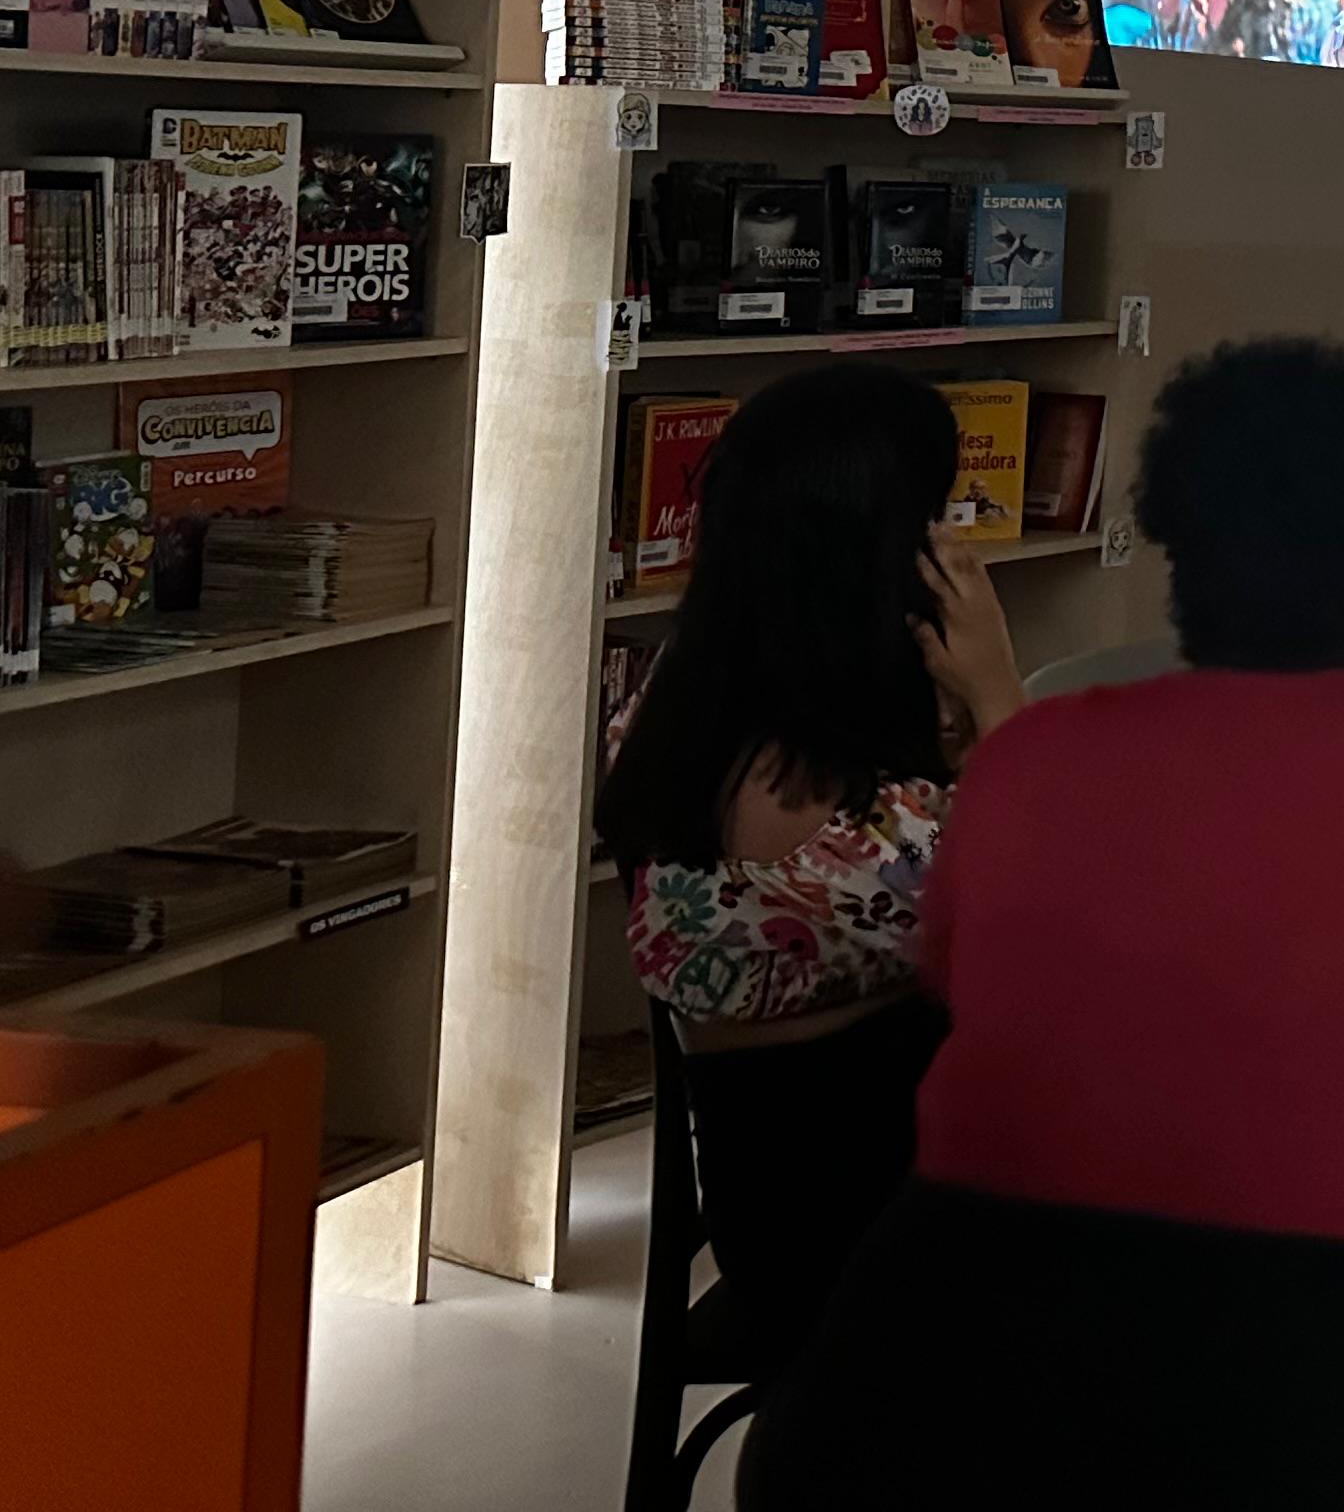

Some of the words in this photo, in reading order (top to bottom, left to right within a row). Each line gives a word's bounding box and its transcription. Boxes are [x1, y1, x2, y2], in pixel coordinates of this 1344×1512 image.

[180, 118, 288, 155] BATMAN
[295, 243, 410, 274] SUPER
[960, 451, 1017, 471] oadora
[172, 467, 257, 488] Percurso
[653, 501, 697, 536] Mort
